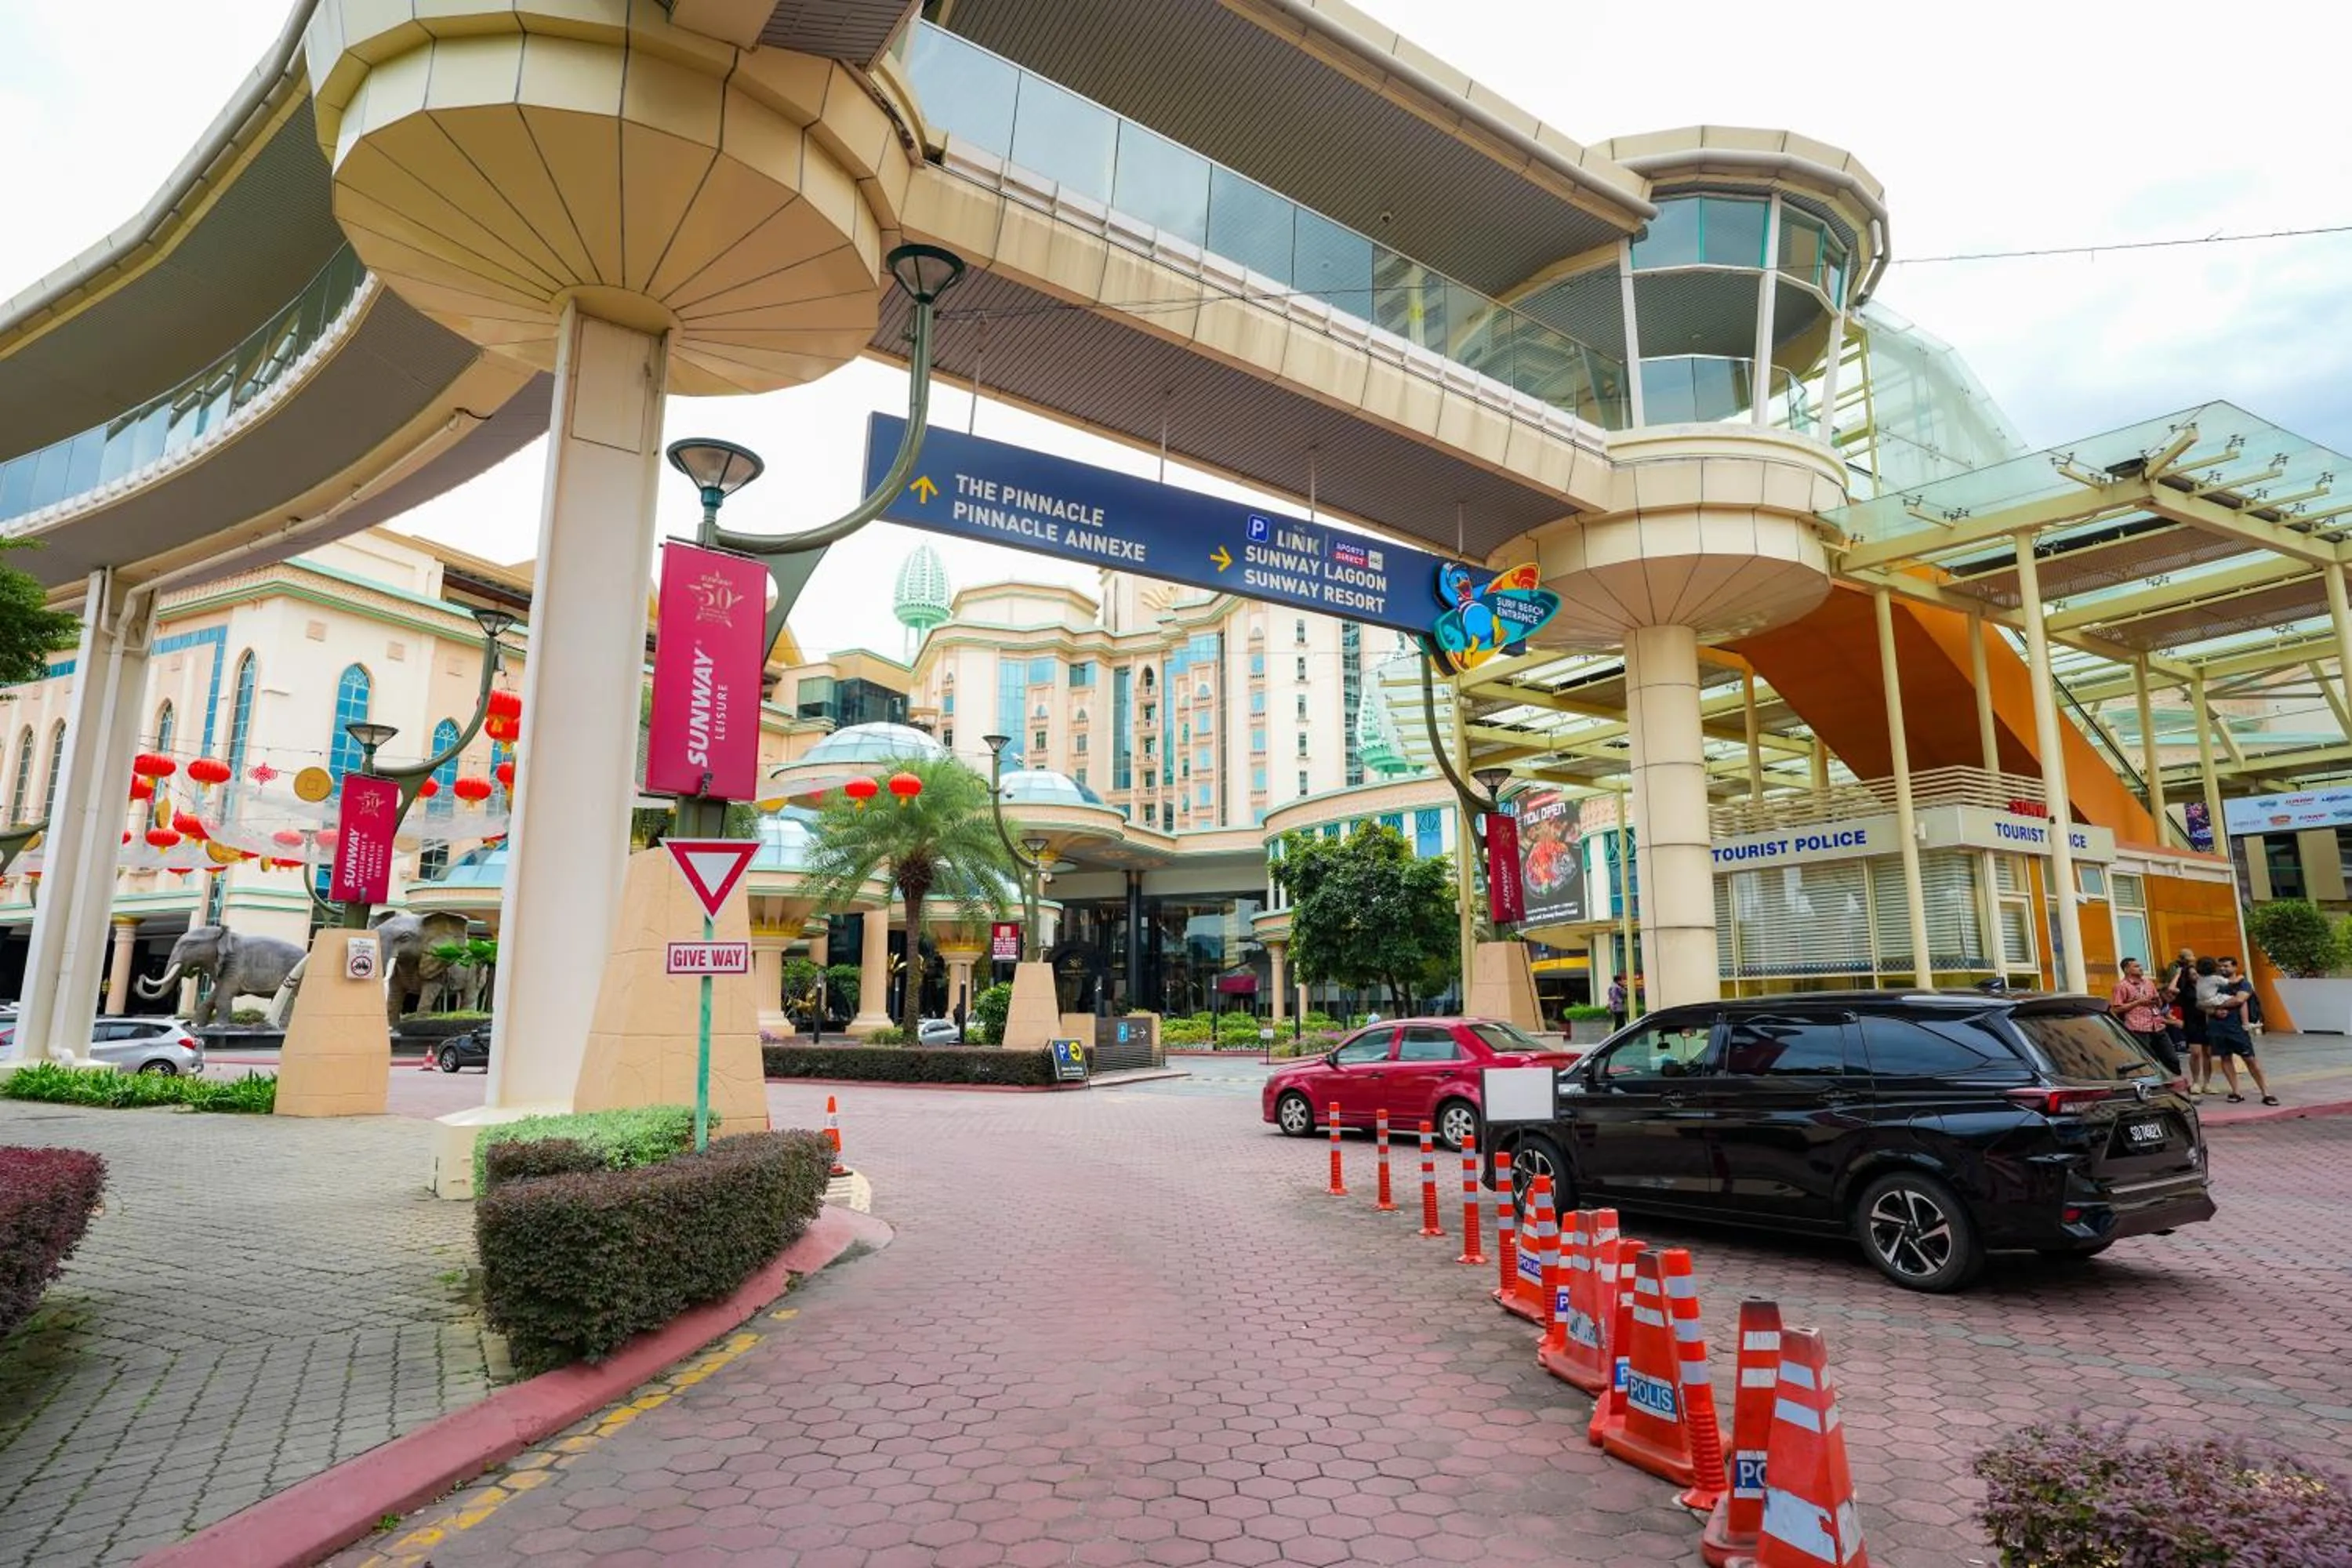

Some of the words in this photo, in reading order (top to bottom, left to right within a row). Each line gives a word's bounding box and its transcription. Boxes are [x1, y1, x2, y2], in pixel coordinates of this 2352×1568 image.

[956, 474, 997, 502] THE
[1002, 485, 1105, 528] PINNACLE
[953, 501, 1058, 543] PINNACLE
[1065, 528, 1146, 562] ANNEXE
[1252, 520, 1265, 537] P
[1276, 530, 1320, 555] LINK
[1245, 545, 1320, 576] SUNWAY
[1324, 563, 1386, 592] LAGOON
[1244, 569, 1319, 598] SUNWAY
[1324, 585, 1385, 614] RESORT
[1496, 597, 1517, 609] SURF
[1518, 601, 1544, 616] BEACH
[1497, 606, 1538, 625] ENTRANCE
[688, 647, 714, 768] SUNWAY
[714, 684, 728, 741] LEISURE
[1711, 840, 1788, 862] TOURIST
[1795, 829, 1867, 852] POLICE
[1994, 822, 2045, 843] TOURIST
[344, 827, 361, 888] SUNWAY
[674, 949, 706, 967] GIVE
[712, 949, 742, 966] WAY
[1519, 1256, 1541, 1276] POLIS
[1629, 1377, 1673, 1410] POLIS
